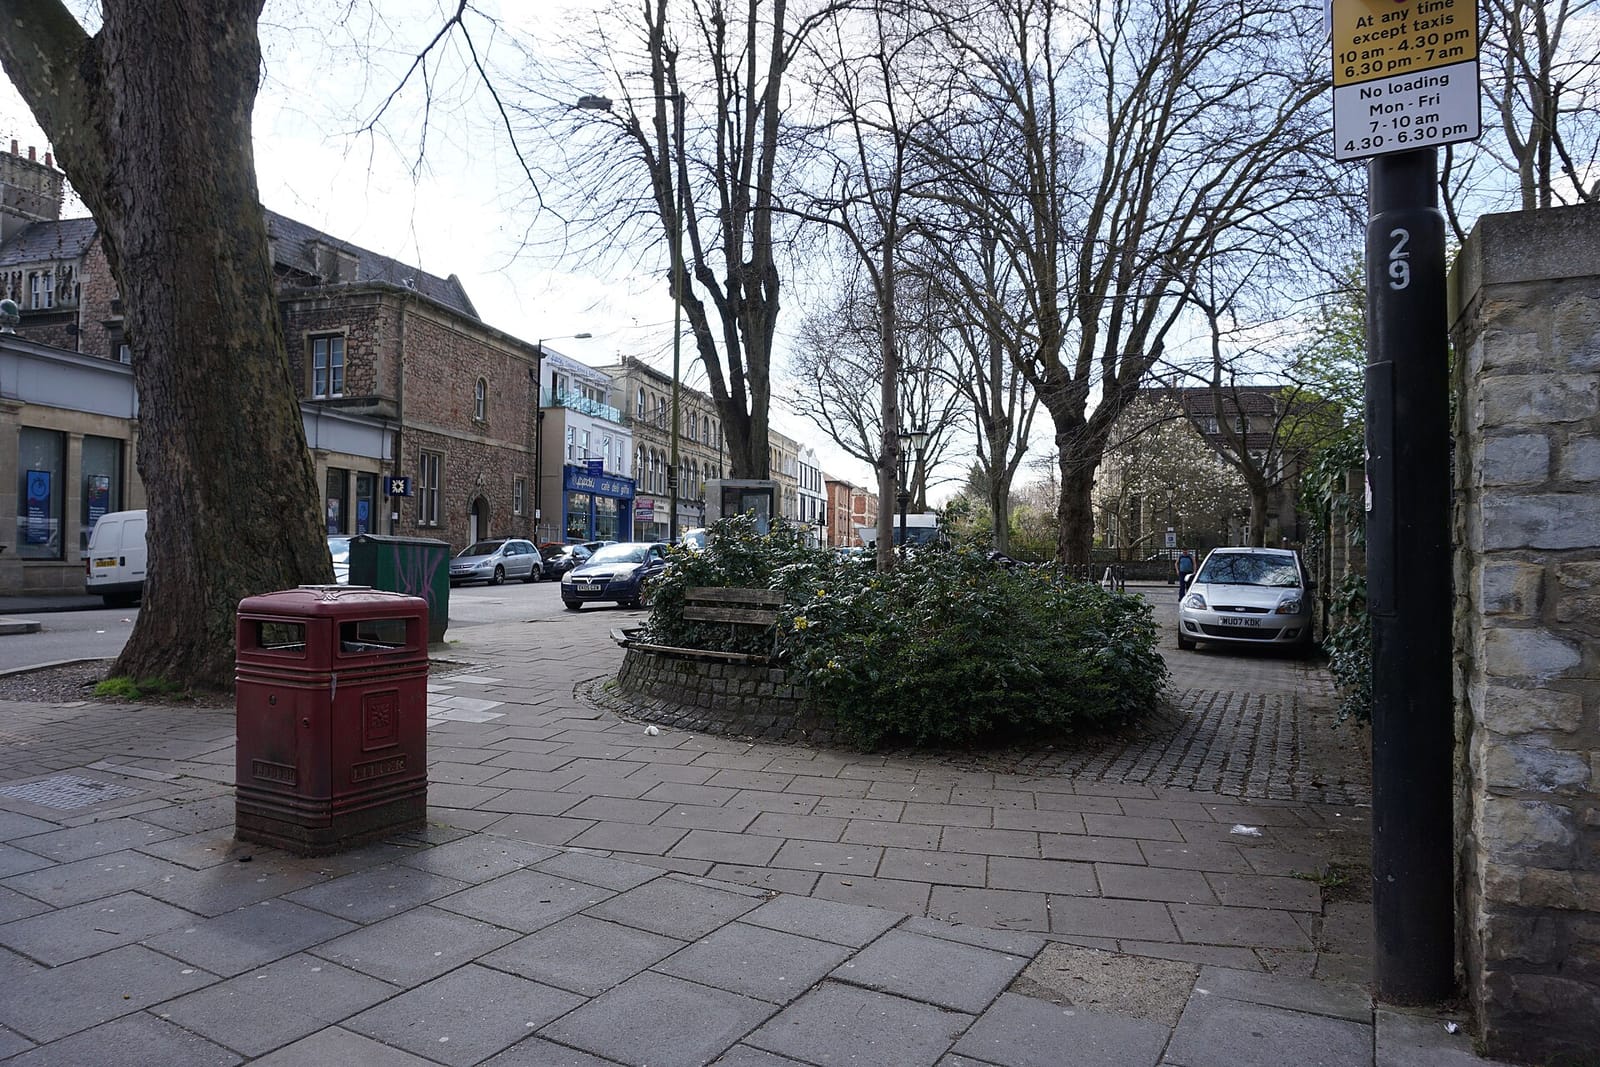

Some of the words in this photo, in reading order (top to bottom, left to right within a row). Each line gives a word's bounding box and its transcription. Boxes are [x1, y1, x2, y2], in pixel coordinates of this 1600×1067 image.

[1356, 15, 1374, 29] At
[1381, 9, 1409, 23] any
[1417, 0, 1454, 15] time
[1352, 24, 1407, 45] except
[1413, 14, 1454, 32] taxis
[1339, 51, 1357, 64] 10
[1361, 47, 1385, 60] am
[1397, 33, 1439, 52] 4.30
[1443, 29, 1469, 44] pm
[1345, 60, 1383, 78] 6.30
[1387, 57, 1412, 71] pm
[1425, 49, 1435, 62] 7
[1438, 45, 1464, 59] am
[1360, 87, 1383, 100] No
[1388, 74, 1449, 94] loading
[1369, 101, 1404, 117] Mon
[1418, 93, 1440, 108] Fri
[1344, 135, 1383, 152] 4.30
[1397, 126, 1438, 144] 6.30
[1442, 123, 1468, 138] pm
[1369, 121, 1379, 133] 7
[1391, 115, 1411, 129] 10
[1415, 113, 1439, 125] am
